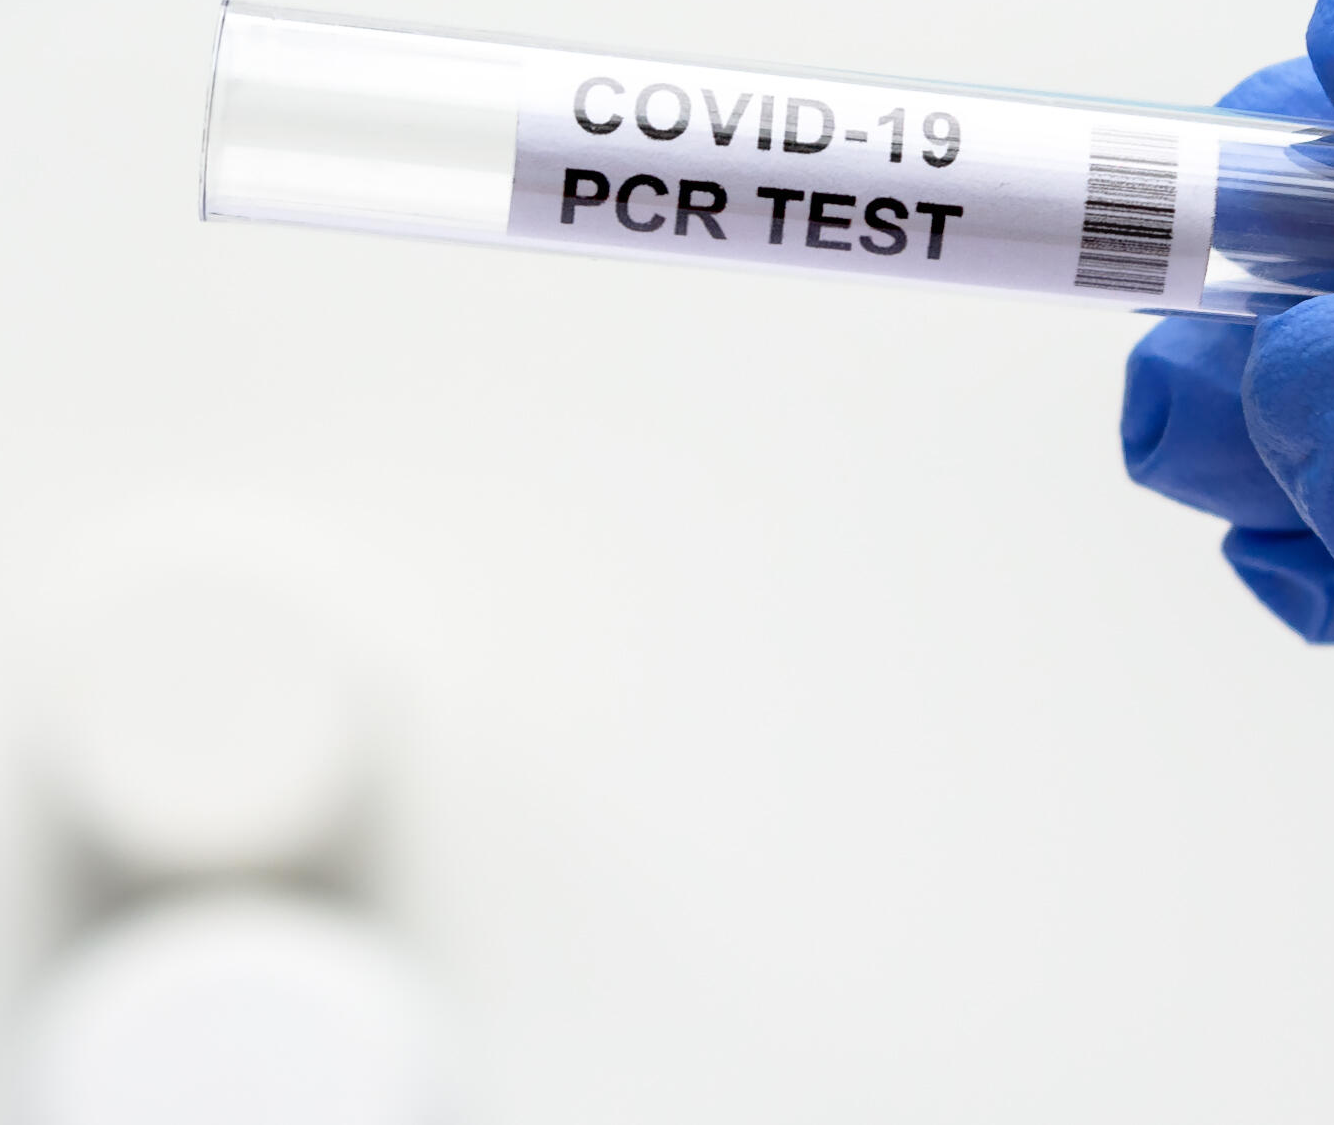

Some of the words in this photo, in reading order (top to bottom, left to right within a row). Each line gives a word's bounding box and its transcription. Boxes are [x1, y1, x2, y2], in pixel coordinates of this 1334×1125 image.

[573, 77, 961, 168] COVID-19
[560, 168, 728, 240] PCR
[756, 186, 964, 261] TEST
